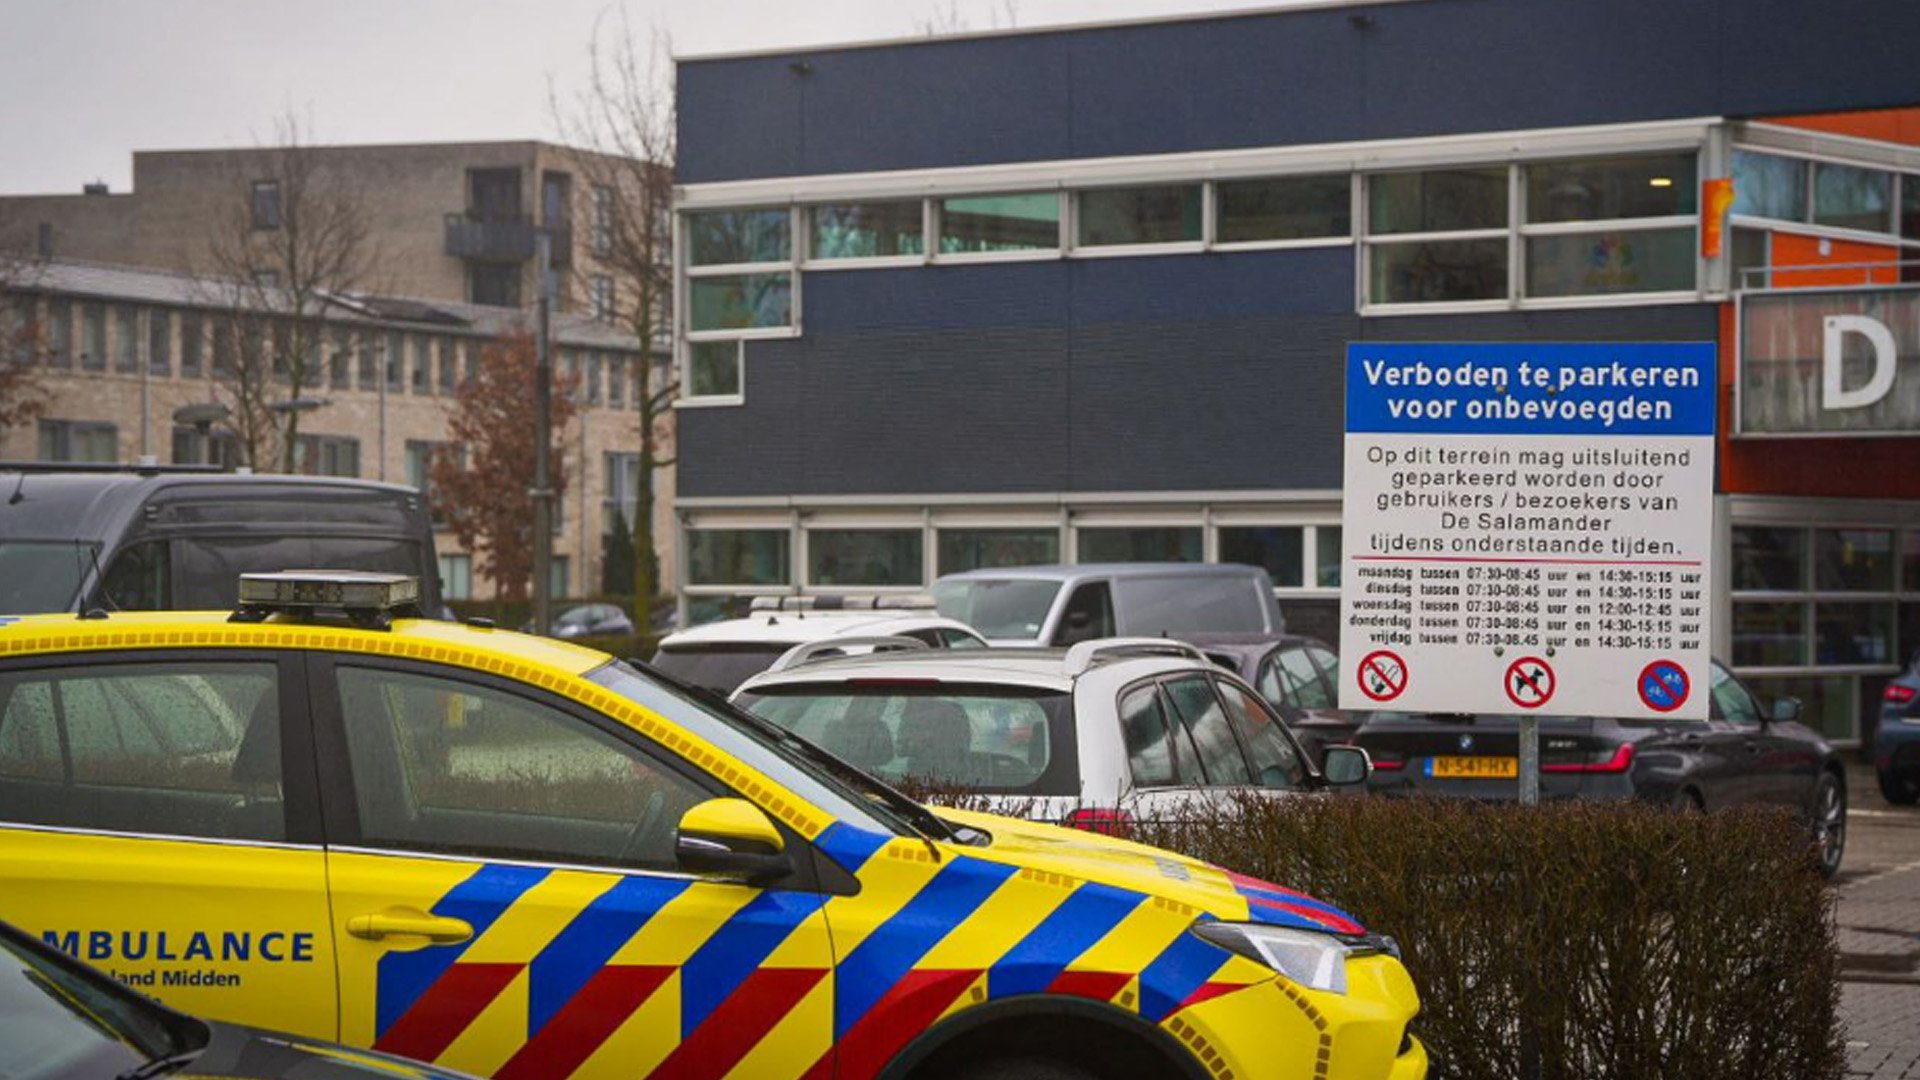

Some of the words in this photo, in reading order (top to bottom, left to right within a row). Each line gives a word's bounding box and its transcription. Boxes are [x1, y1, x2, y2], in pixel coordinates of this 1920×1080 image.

[1822, 314, 1898, 410] D
[1363, 359, 1508, 387] Verboden
[1518, 362, 1550, 387] te
[1559, 362, 1699, 392] parkeren
[1388, 399, 1457, 420] voor
[1466, 395, 1672, 427] onbevoegden
[1366, 445, 1398, 466] Op
[1403, 446, 1432, 464] dit
[1438, 447, 1511, 465] terrein
[1518, 451, 1564, 469] mag
[1572, 447, 1691, 467] uitsluitend
[1391, 469, 1517, 489] geparkeerd
[1524, 470, 1606, 488] worden
[1612, 471, 1664, 488] door
[1376, 490, 1494, 511] gebruikers
[1500, 492, 1508, 508] /
[1515, 492, 1631, 511] bezoekers
[1639, 496, 1678, 511] van
[1441, 511, 1470, 530] De
[1477, 512, 1612, 532] Salamander
[1370, 533, 1444, 554] tijdens
[1451, 534, 1604, 554] onderstaande
[1611, 537, 1683, 558] tijden.
[1358, 566, 1413, 581] maandag
[1420, 567, 1460, 580] tussen
[1466, 566, 1541, 581] 07:30-08:45
[1547, 571, 1568, 583] uur
[1575, 571, 1592, 583] en
[1599, 569, 1673, 585] 14:30-15:15
[1680, 573, 1702, 585] uur
[1365, 582, 1413, 597] dinsdag
[1420, 583, 1460, 596] tussen
[1466, 582, 1541, 597] 07:30-08:45
[1547, 587, 1568, 599] uur
[1575, 587, 1592, 599] en
[1599, 585, 1673, 601] 14:30-15:15
[1680, 589, 1702, 601] uur
[1352, 598, 1412, 614] woensdag
[1420, 600, 1460, 613] tussen
[1466, 599, 1541, 614] 07:30-08:45
[1547, 603, 1568, 615] uur
[1575, 603, 1592, 615] en
[1599, 601, 1673, 617] 12:00-12:45
[1680, 606, 1702, 618] uur
[1349, 614, 1412, 630] donderdag
[1419, 616, 1459, 629] tussen
[1465, 615, 1540, 630] 07:30-08:45
[1546, 619, 1568, 631] uur
[1574, 619, 1592, 631] en
[1598, 617, 1672, 633] 14:30-15:15
[1679, 622, 1701, 634] uur
[1369, 630, 1412, 646] vrijdag
[1419, 632, 1459, 645] tussen
[1546, 636, 1568, 648] uur
[1574, 636, 1592, 648] en
[1598, 634, 1672, 650] 14:30-15:15
[1679, 639, 1701, 651] uur
[42, 931, 314, 962] MBULANCE
[162, 969, 241, 987] Midden
